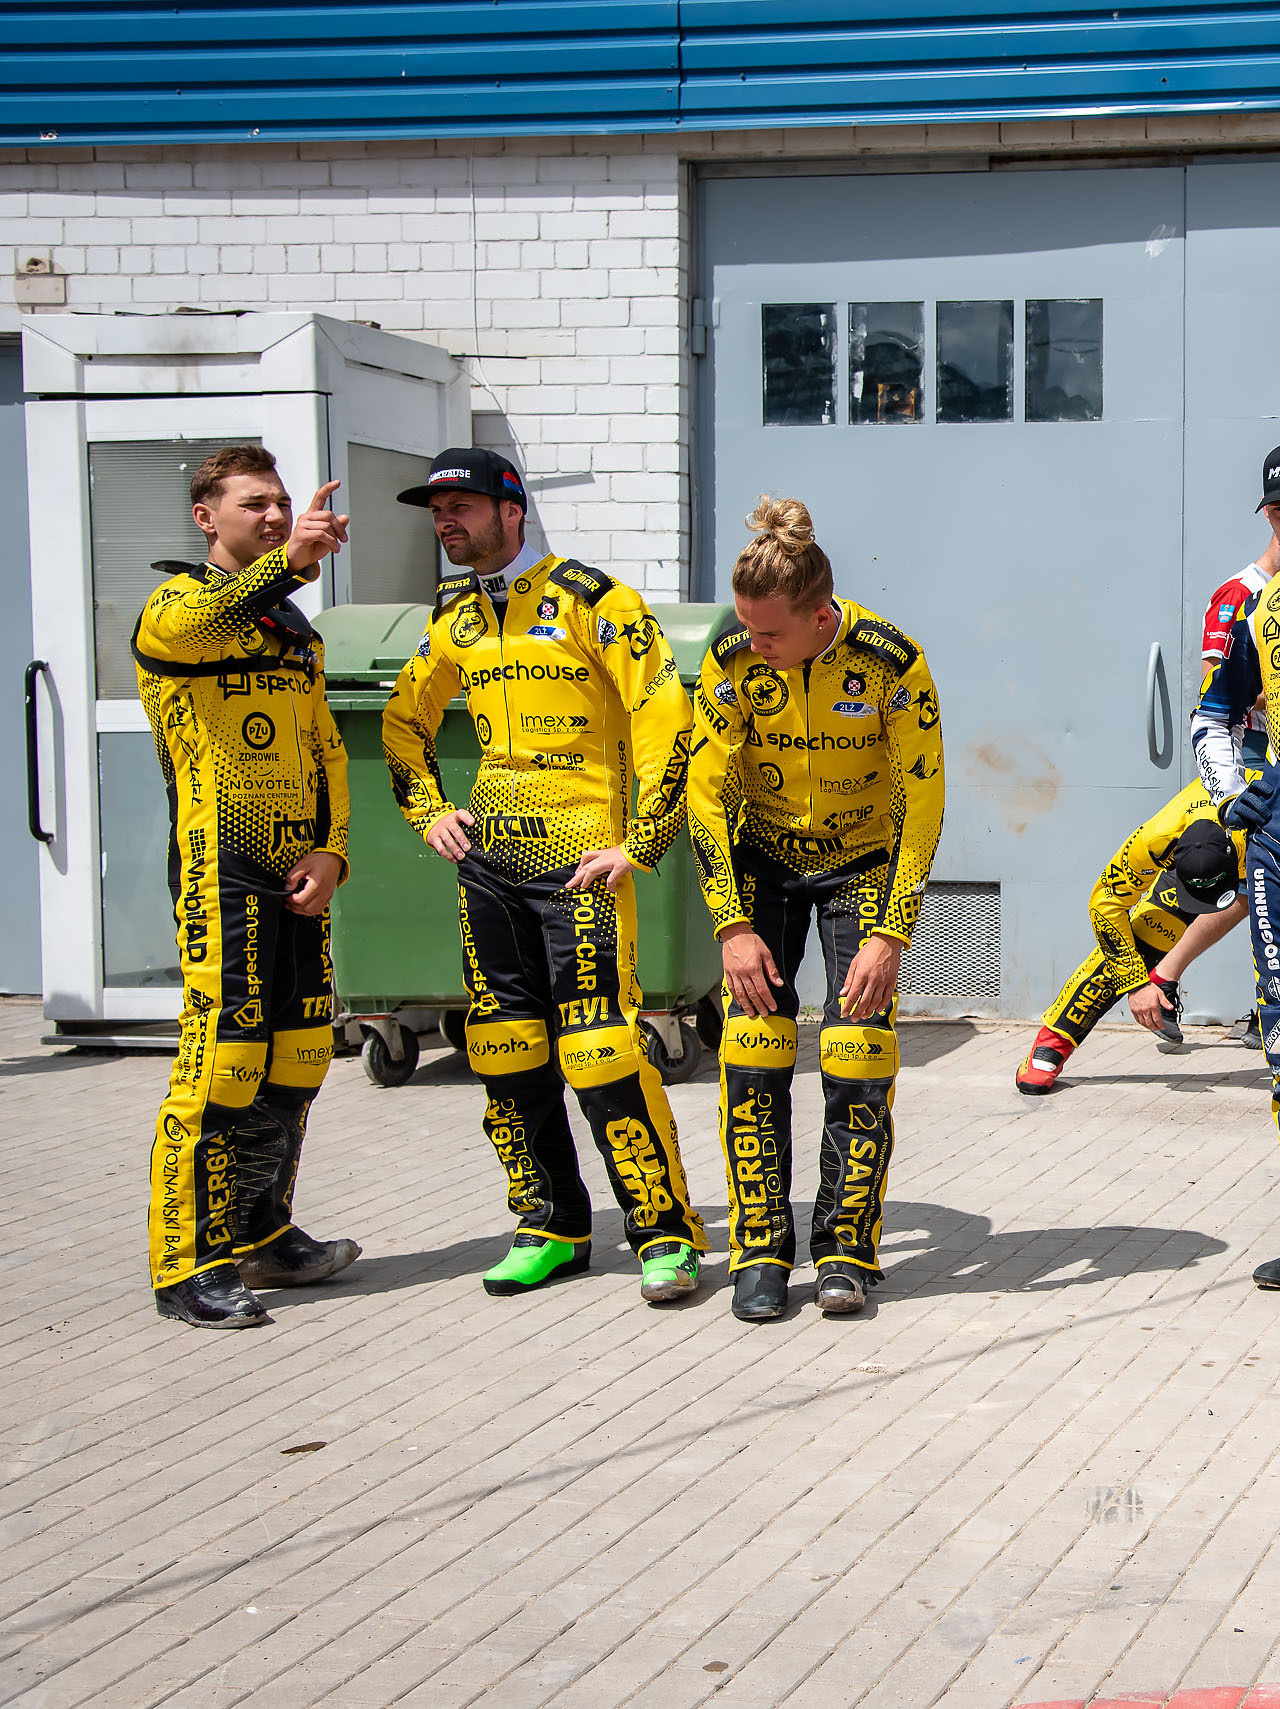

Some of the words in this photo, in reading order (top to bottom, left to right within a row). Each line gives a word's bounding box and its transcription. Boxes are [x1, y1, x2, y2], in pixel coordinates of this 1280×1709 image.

[256, 673, 311, 695] specho
[472, 660, 590, 689] spechouse
[249, 722, 268, 739] PZU
[520, 713, 567, 727] Imex
[767, 731, 885, 751] spechouse
[239, 752, 280, 762] ZDROWIE
[550, 753, 584, 766] mjp
[230, 779, 299, 790] NOVOTEL
[819, 777, 862, 790] Imex
[842, 804, 874, 820] mjp
[1253, 868, 1280, 971] BOGDANKA
[243, 894, 263, 995] spechouse
[320, 902, 332, 984] OL-CAR
[457, 885, 488, 992] spechouse
[572, 892, 597, 992] POL-CAR
[469, 1038, 530, 1057] Kubota
[564, 1048, 593, 1065] Imex
[826, 1040, 865, 1055] Imex
[758, 1092, 785, 1211] HOLDING
[733, 1098, 771, 1249] ENERGIA
[163, 1145, 183, 1229] POZNAŃSKI
[836, 1137, 877, 1248] SANTO
[165, 1235, 181, 1272] BANK
